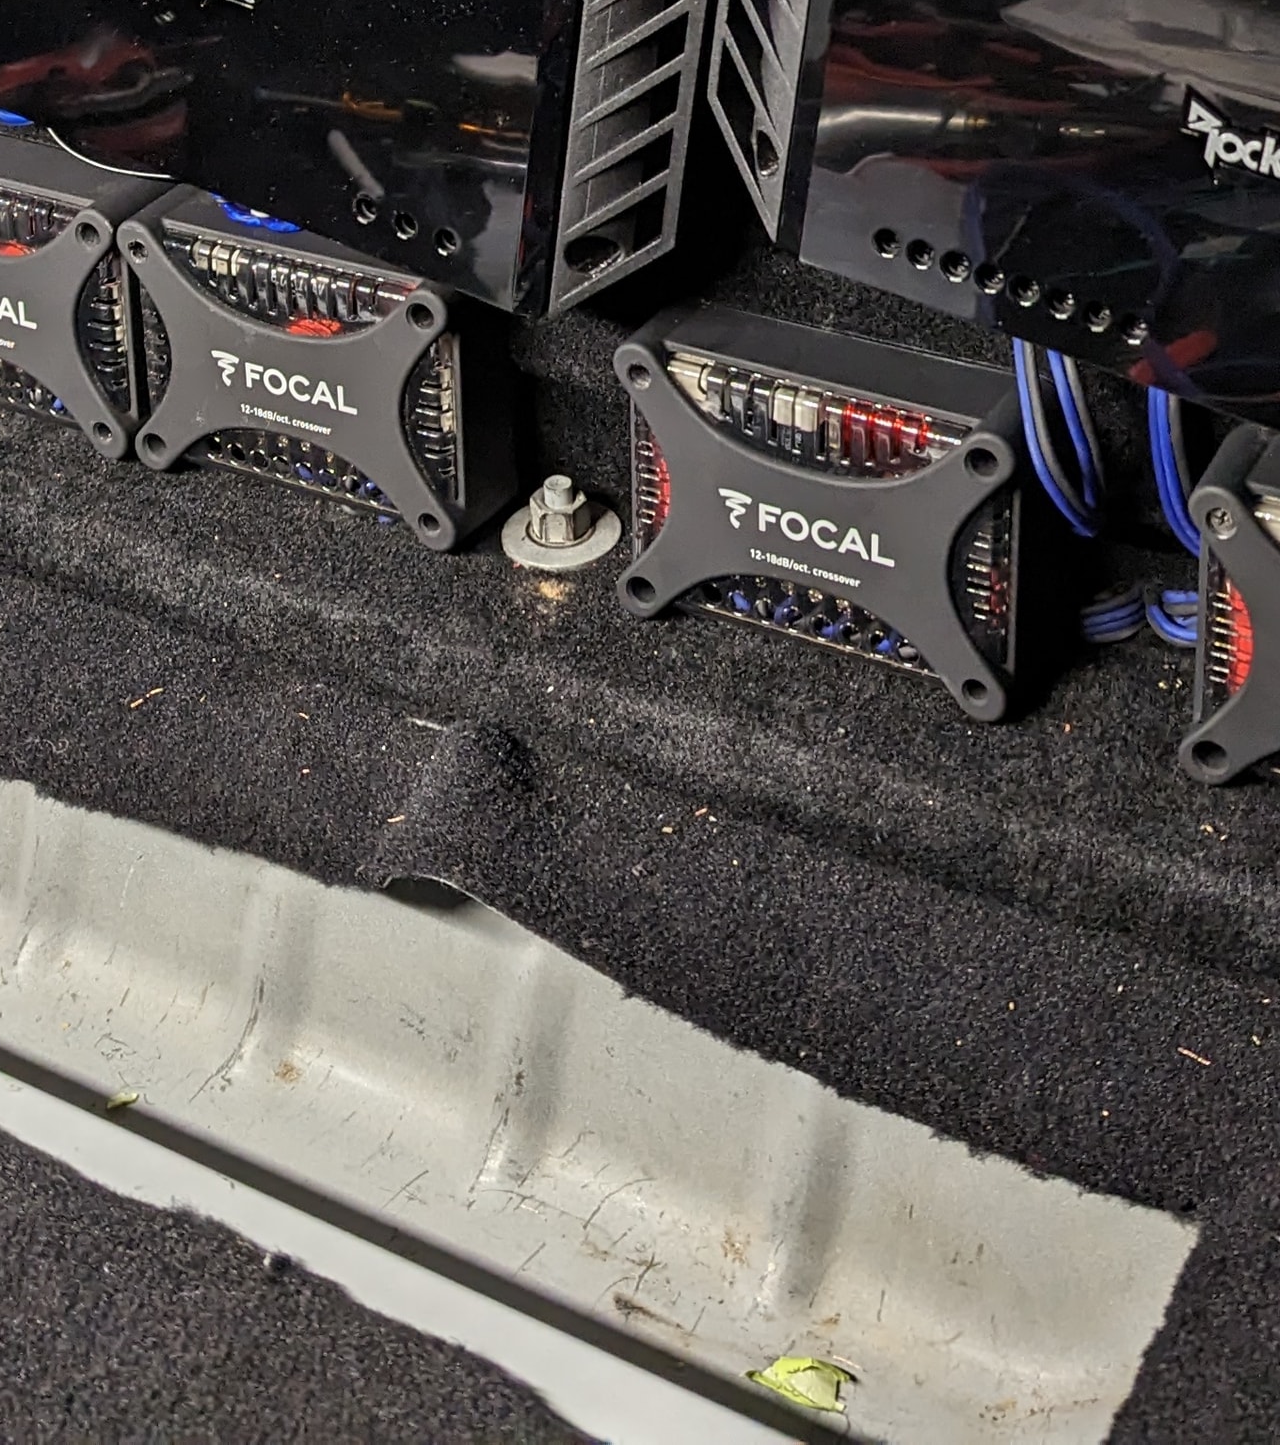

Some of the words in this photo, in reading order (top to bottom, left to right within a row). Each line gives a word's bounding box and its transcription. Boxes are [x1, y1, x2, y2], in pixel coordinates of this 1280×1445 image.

[244, 362, 358, 416] FOCAL
[240, 403, 291, 425] 12-18dB/oct.
[292, 418, 332, 435] crossover
[758, 502, 895, 568] FOCAL
[750, 548, 811, 575] 12-18dB/oct.
[812, 566, 861, 588] crossover
